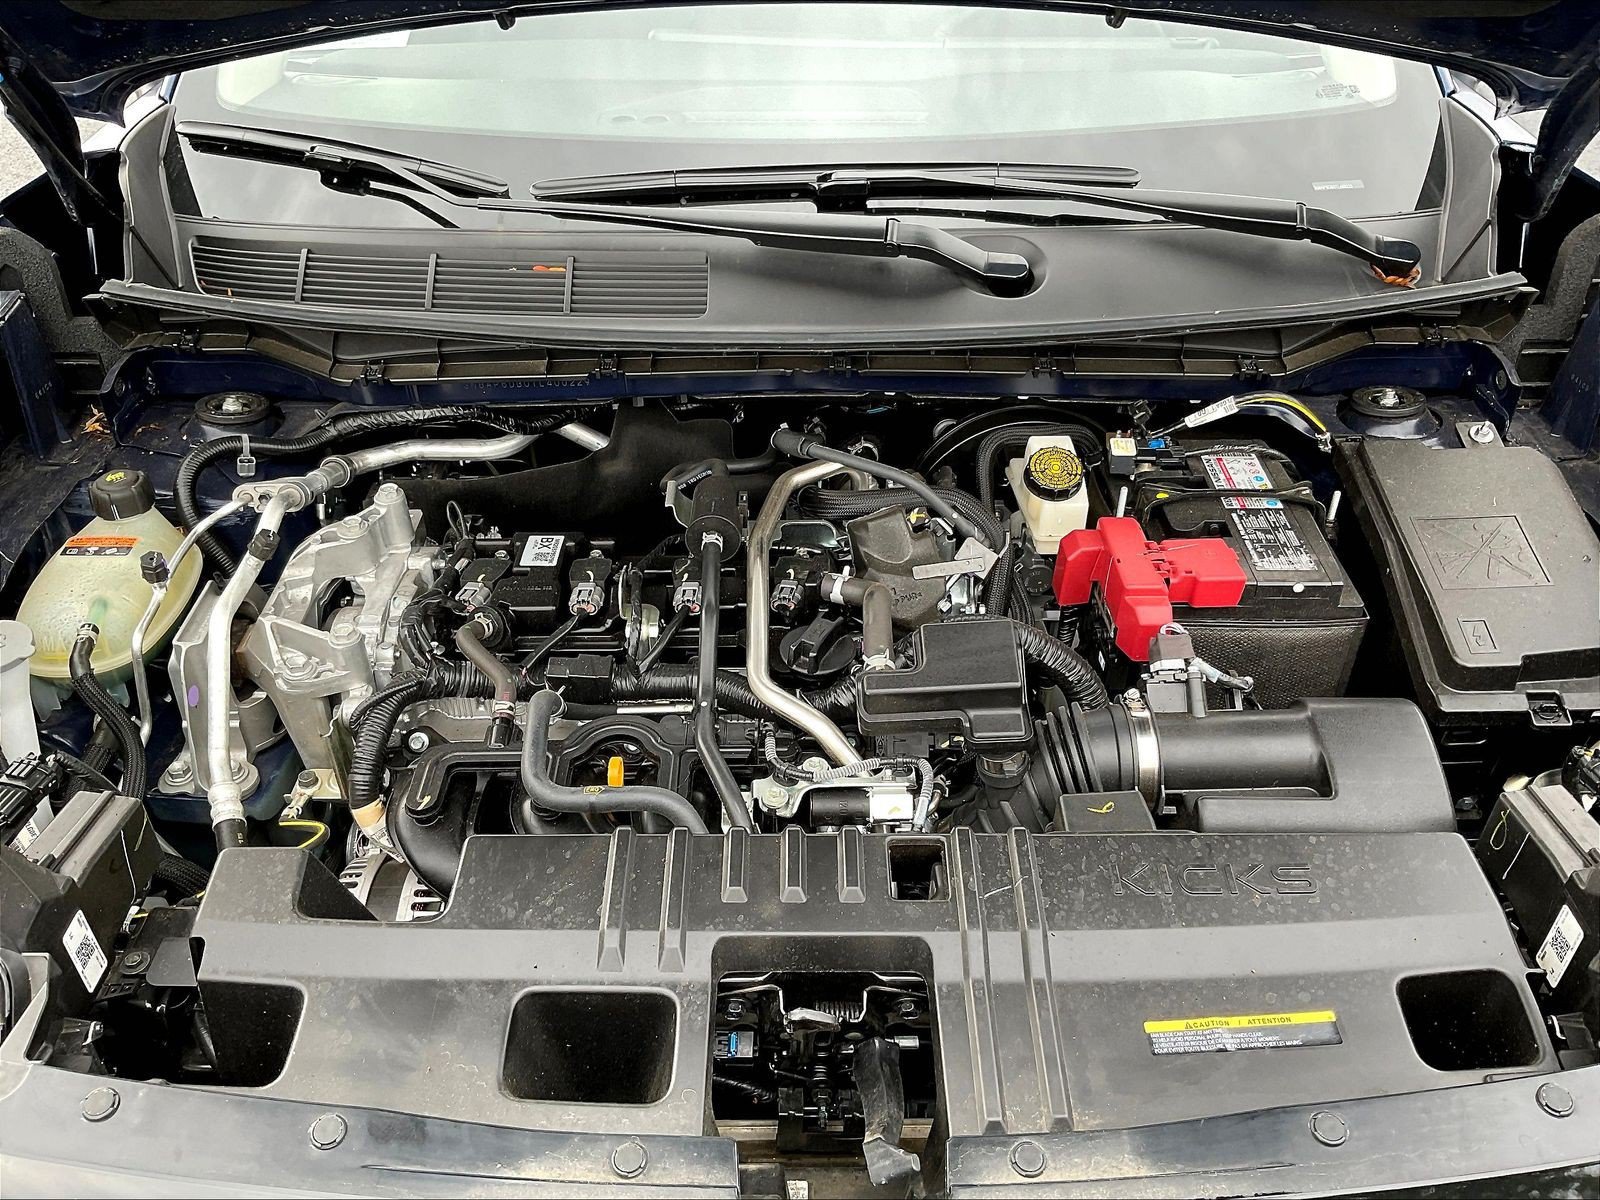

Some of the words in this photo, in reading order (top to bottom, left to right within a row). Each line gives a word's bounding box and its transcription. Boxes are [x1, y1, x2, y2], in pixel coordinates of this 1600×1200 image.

[538, 537, 555, 550] BX
[1111, 863, 1319, 896] KICKS
[1193, 1020, 1230, 1028] CAUTION
[1247, 1016, 1292, 1025] ATTENTION
